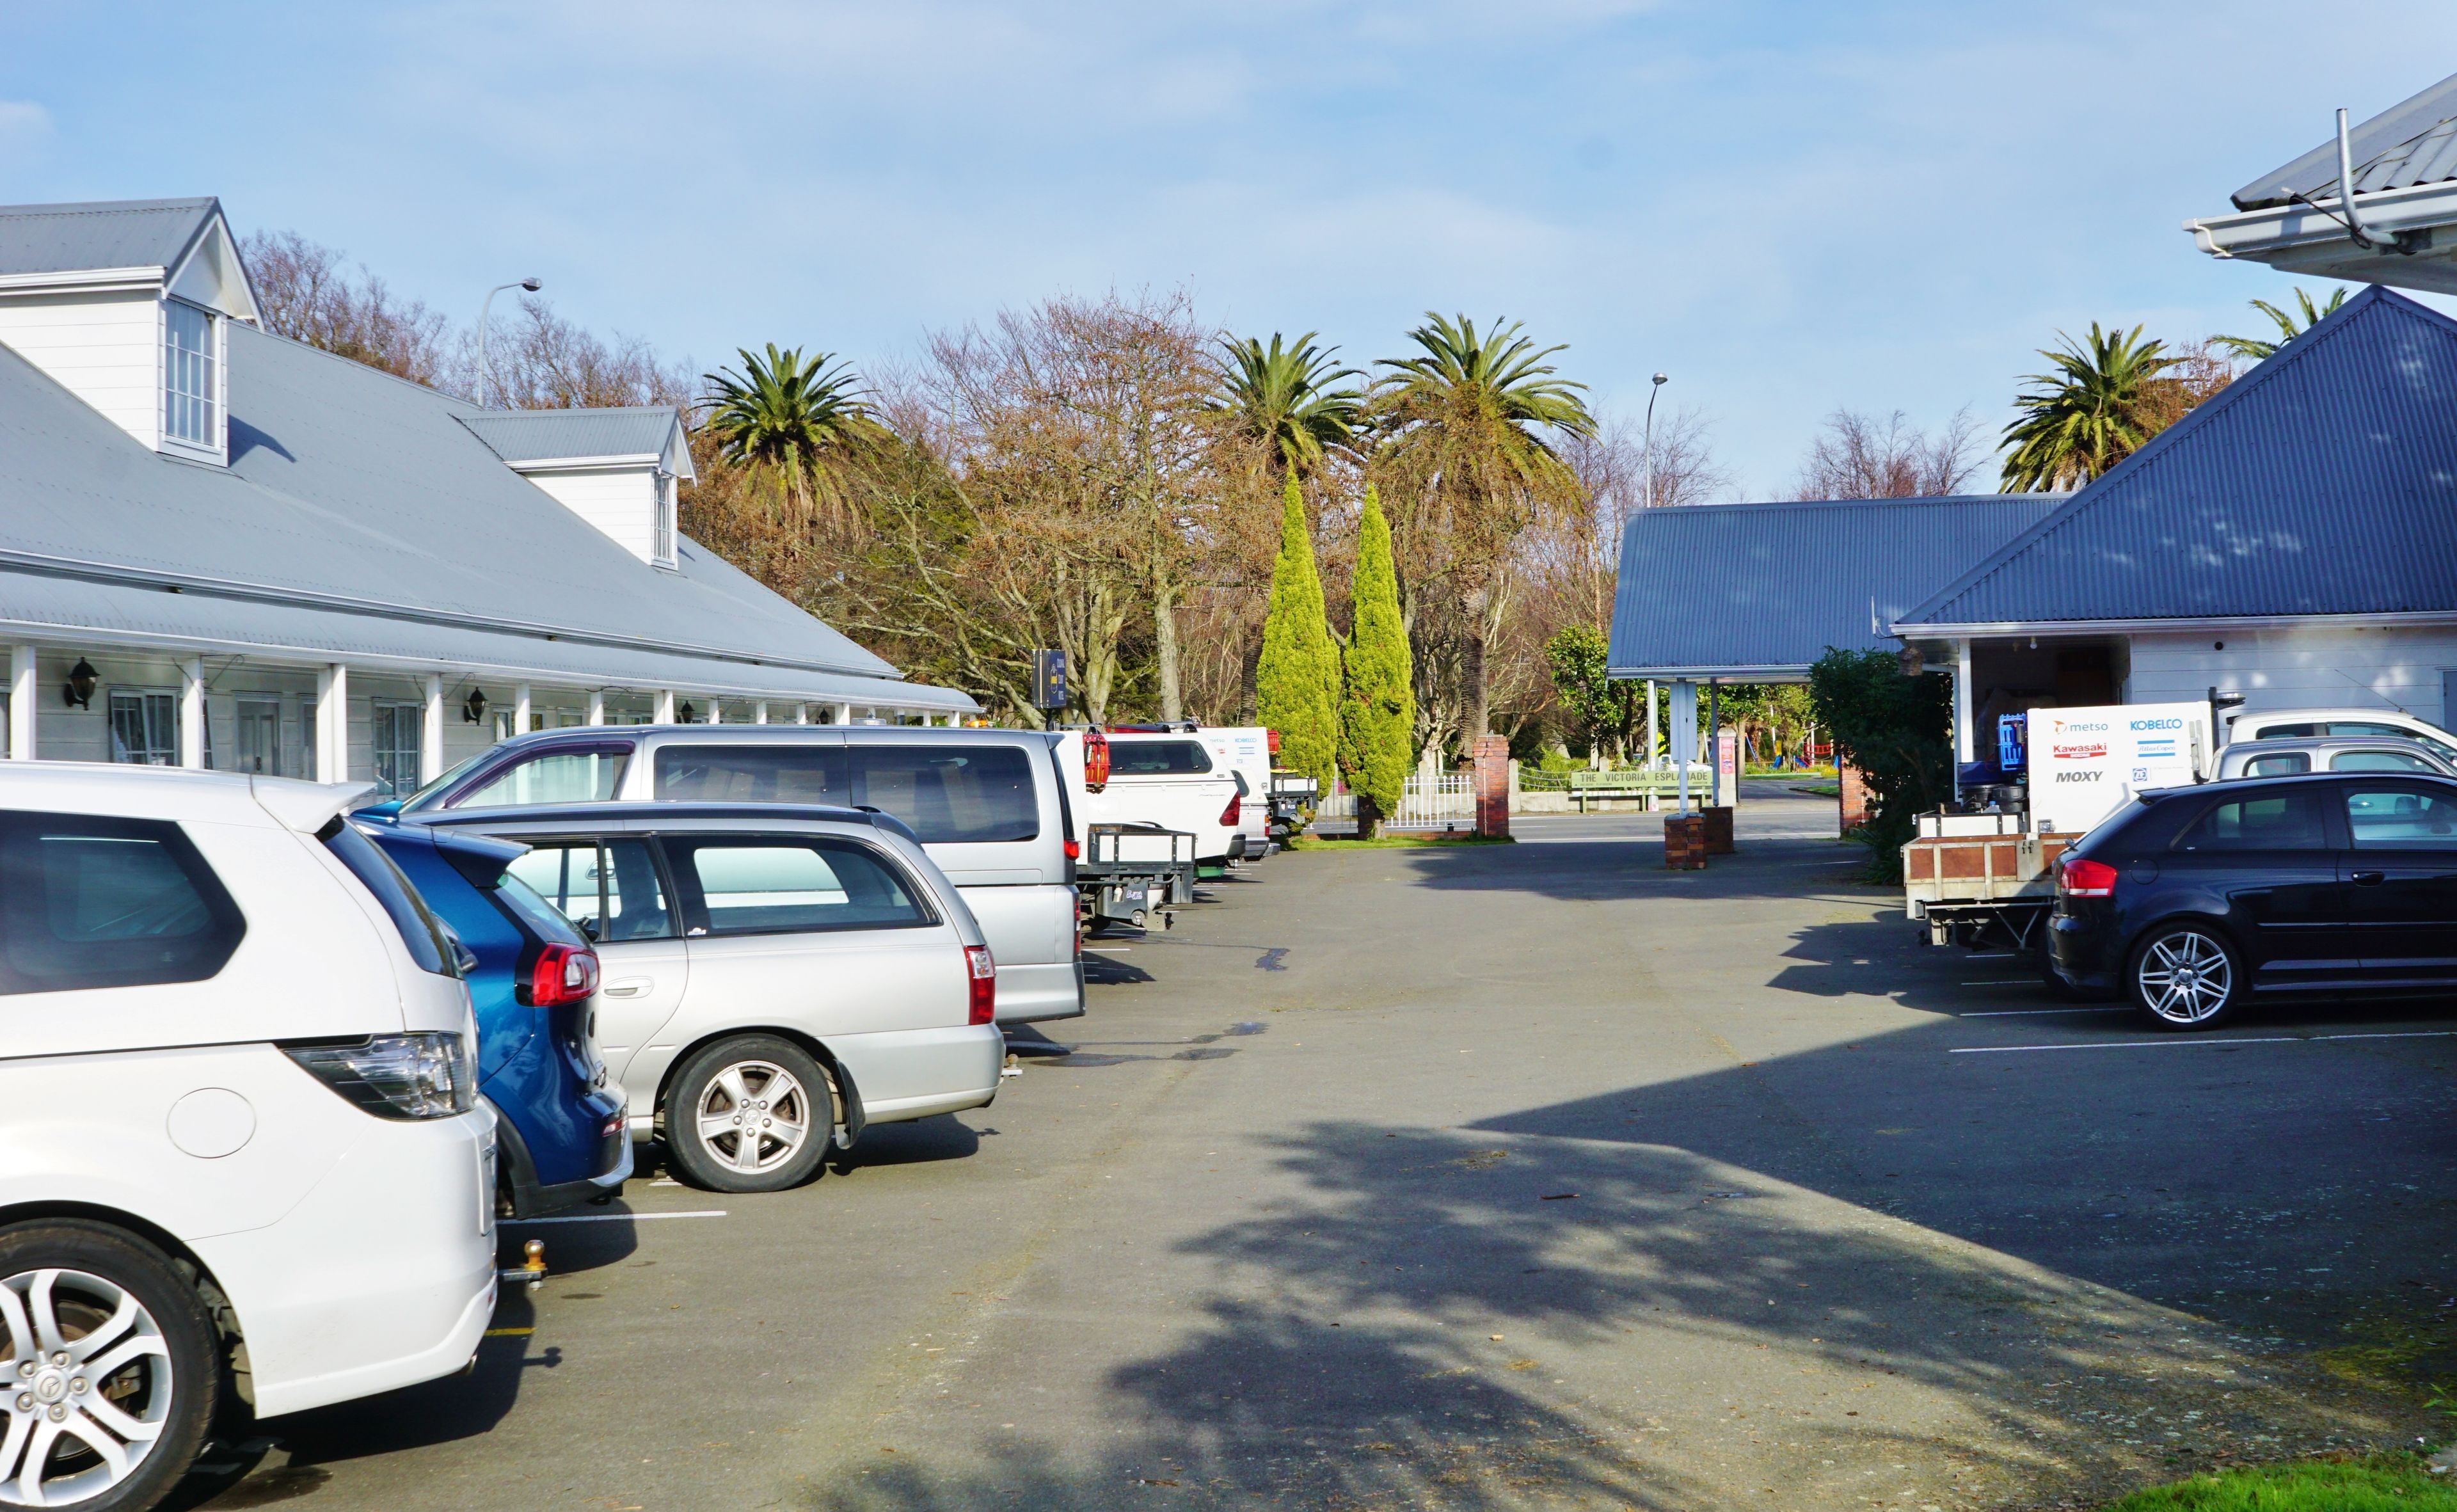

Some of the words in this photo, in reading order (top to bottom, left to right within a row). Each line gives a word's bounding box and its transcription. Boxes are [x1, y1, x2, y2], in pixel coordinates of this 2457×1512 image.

[2070, 723, 2108, 732] metso
[2130, 719, 2183, 731] KOBELCO
[2053, 742, 2107, 752] Kawasaki
[1580, 774, 1596, 782] THE
[1605, 773, 1646, 782] VICTORIA
[2056, 771, 2103, 783] MOXY
